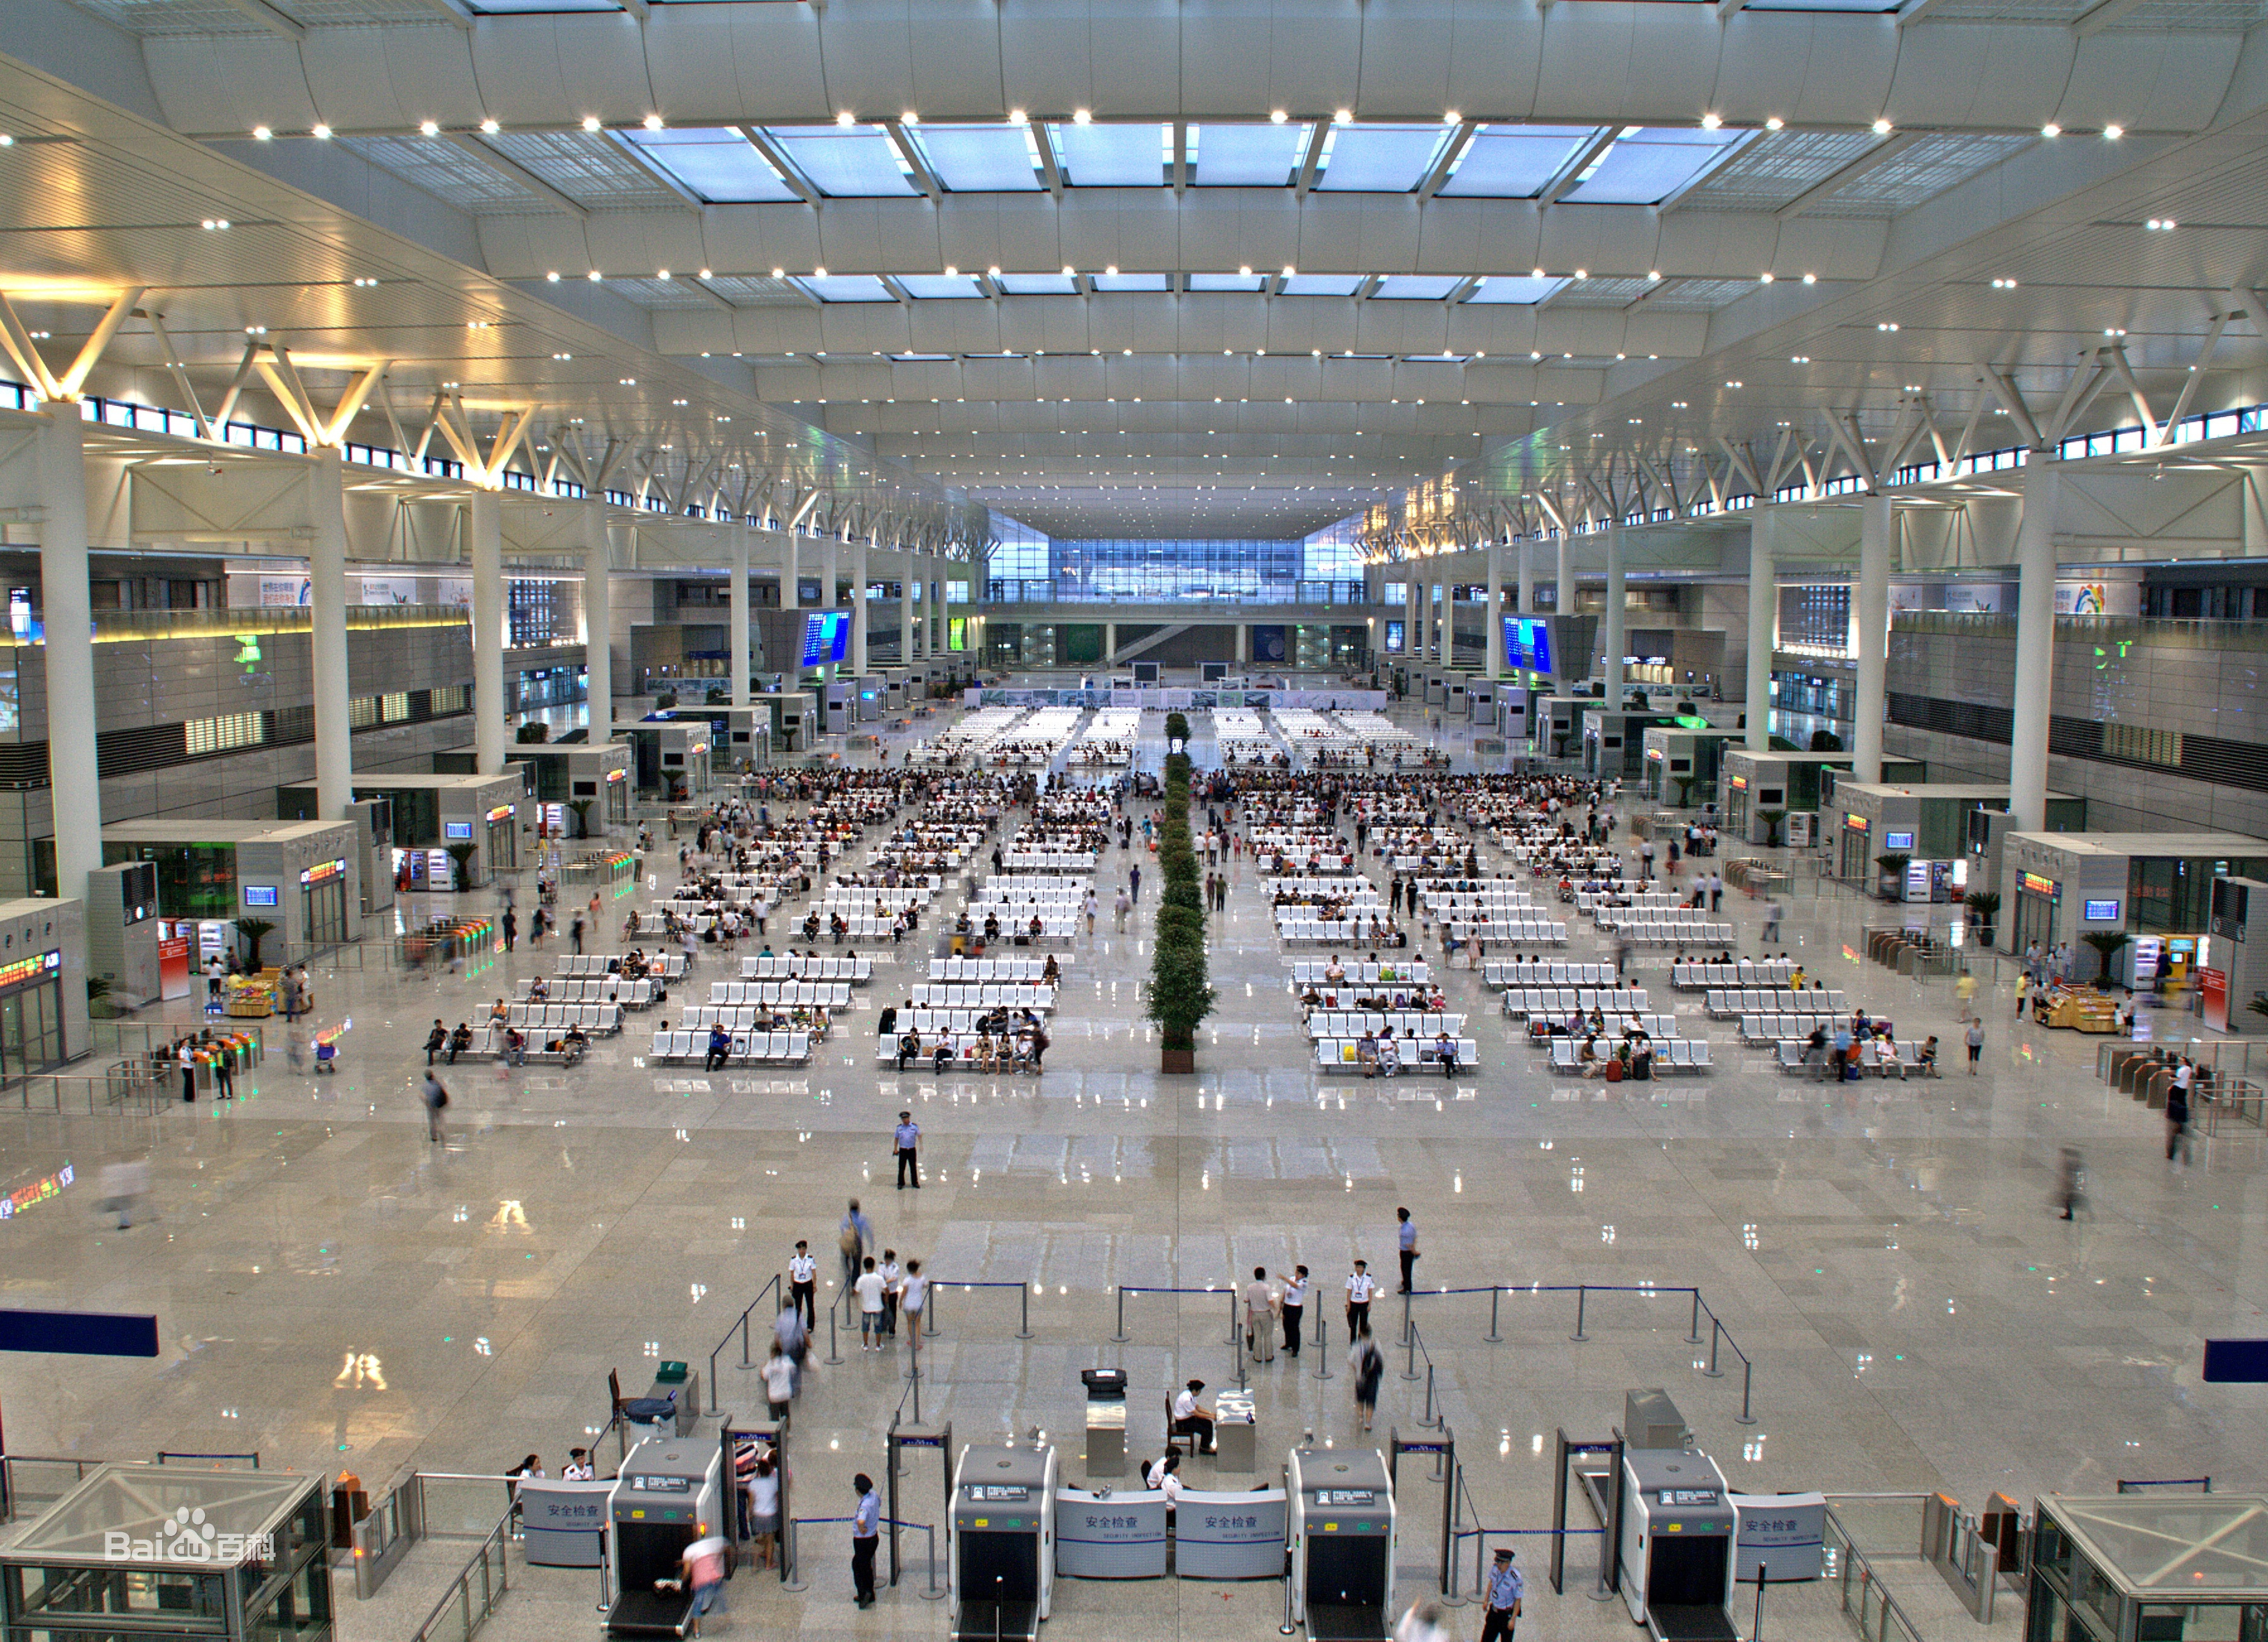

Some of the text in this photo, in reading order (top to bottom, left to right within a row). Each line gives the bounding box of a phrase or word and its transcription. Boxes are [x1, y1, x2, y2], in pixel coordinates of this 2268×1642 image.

[547, 1504, 598, 1516] 安全检查
[1085, 1516, 1137, 1528] 安全检查
[1205, 1516, 1257, 1528] 安全检查
[1745, 1519, 1797, 1532] 安全检查
